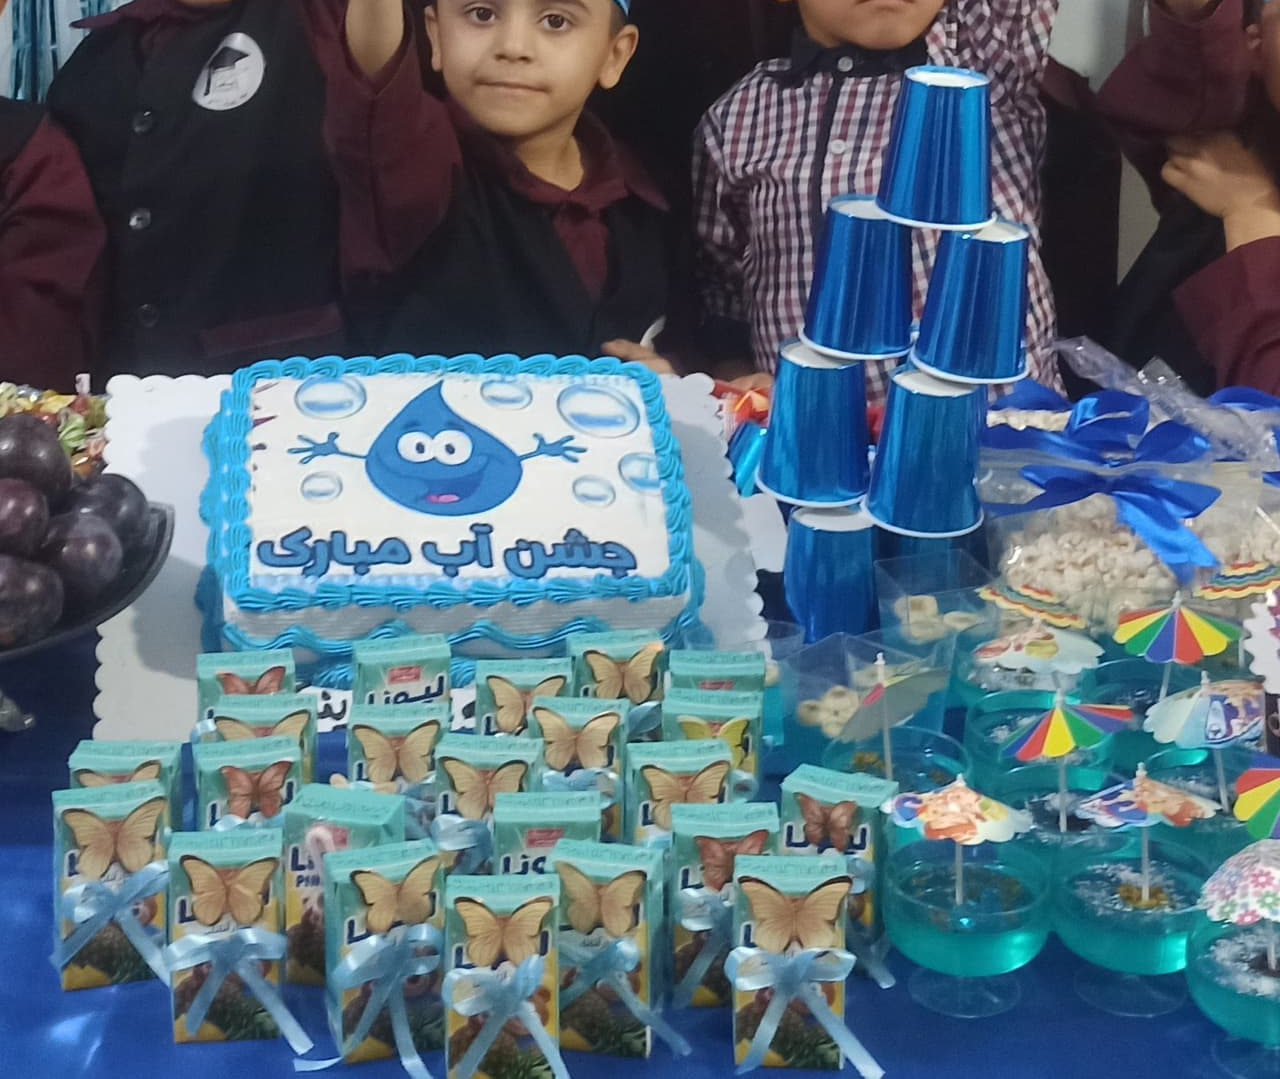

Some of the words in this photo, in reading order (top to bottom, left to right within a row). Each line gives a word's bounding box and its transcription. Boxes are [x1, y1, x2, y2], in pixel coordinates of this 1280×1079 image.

[255, 525, 413, 578] مبارک
[420, 521, 495, 578] آب
[503, 527, 638, 580] جشن
